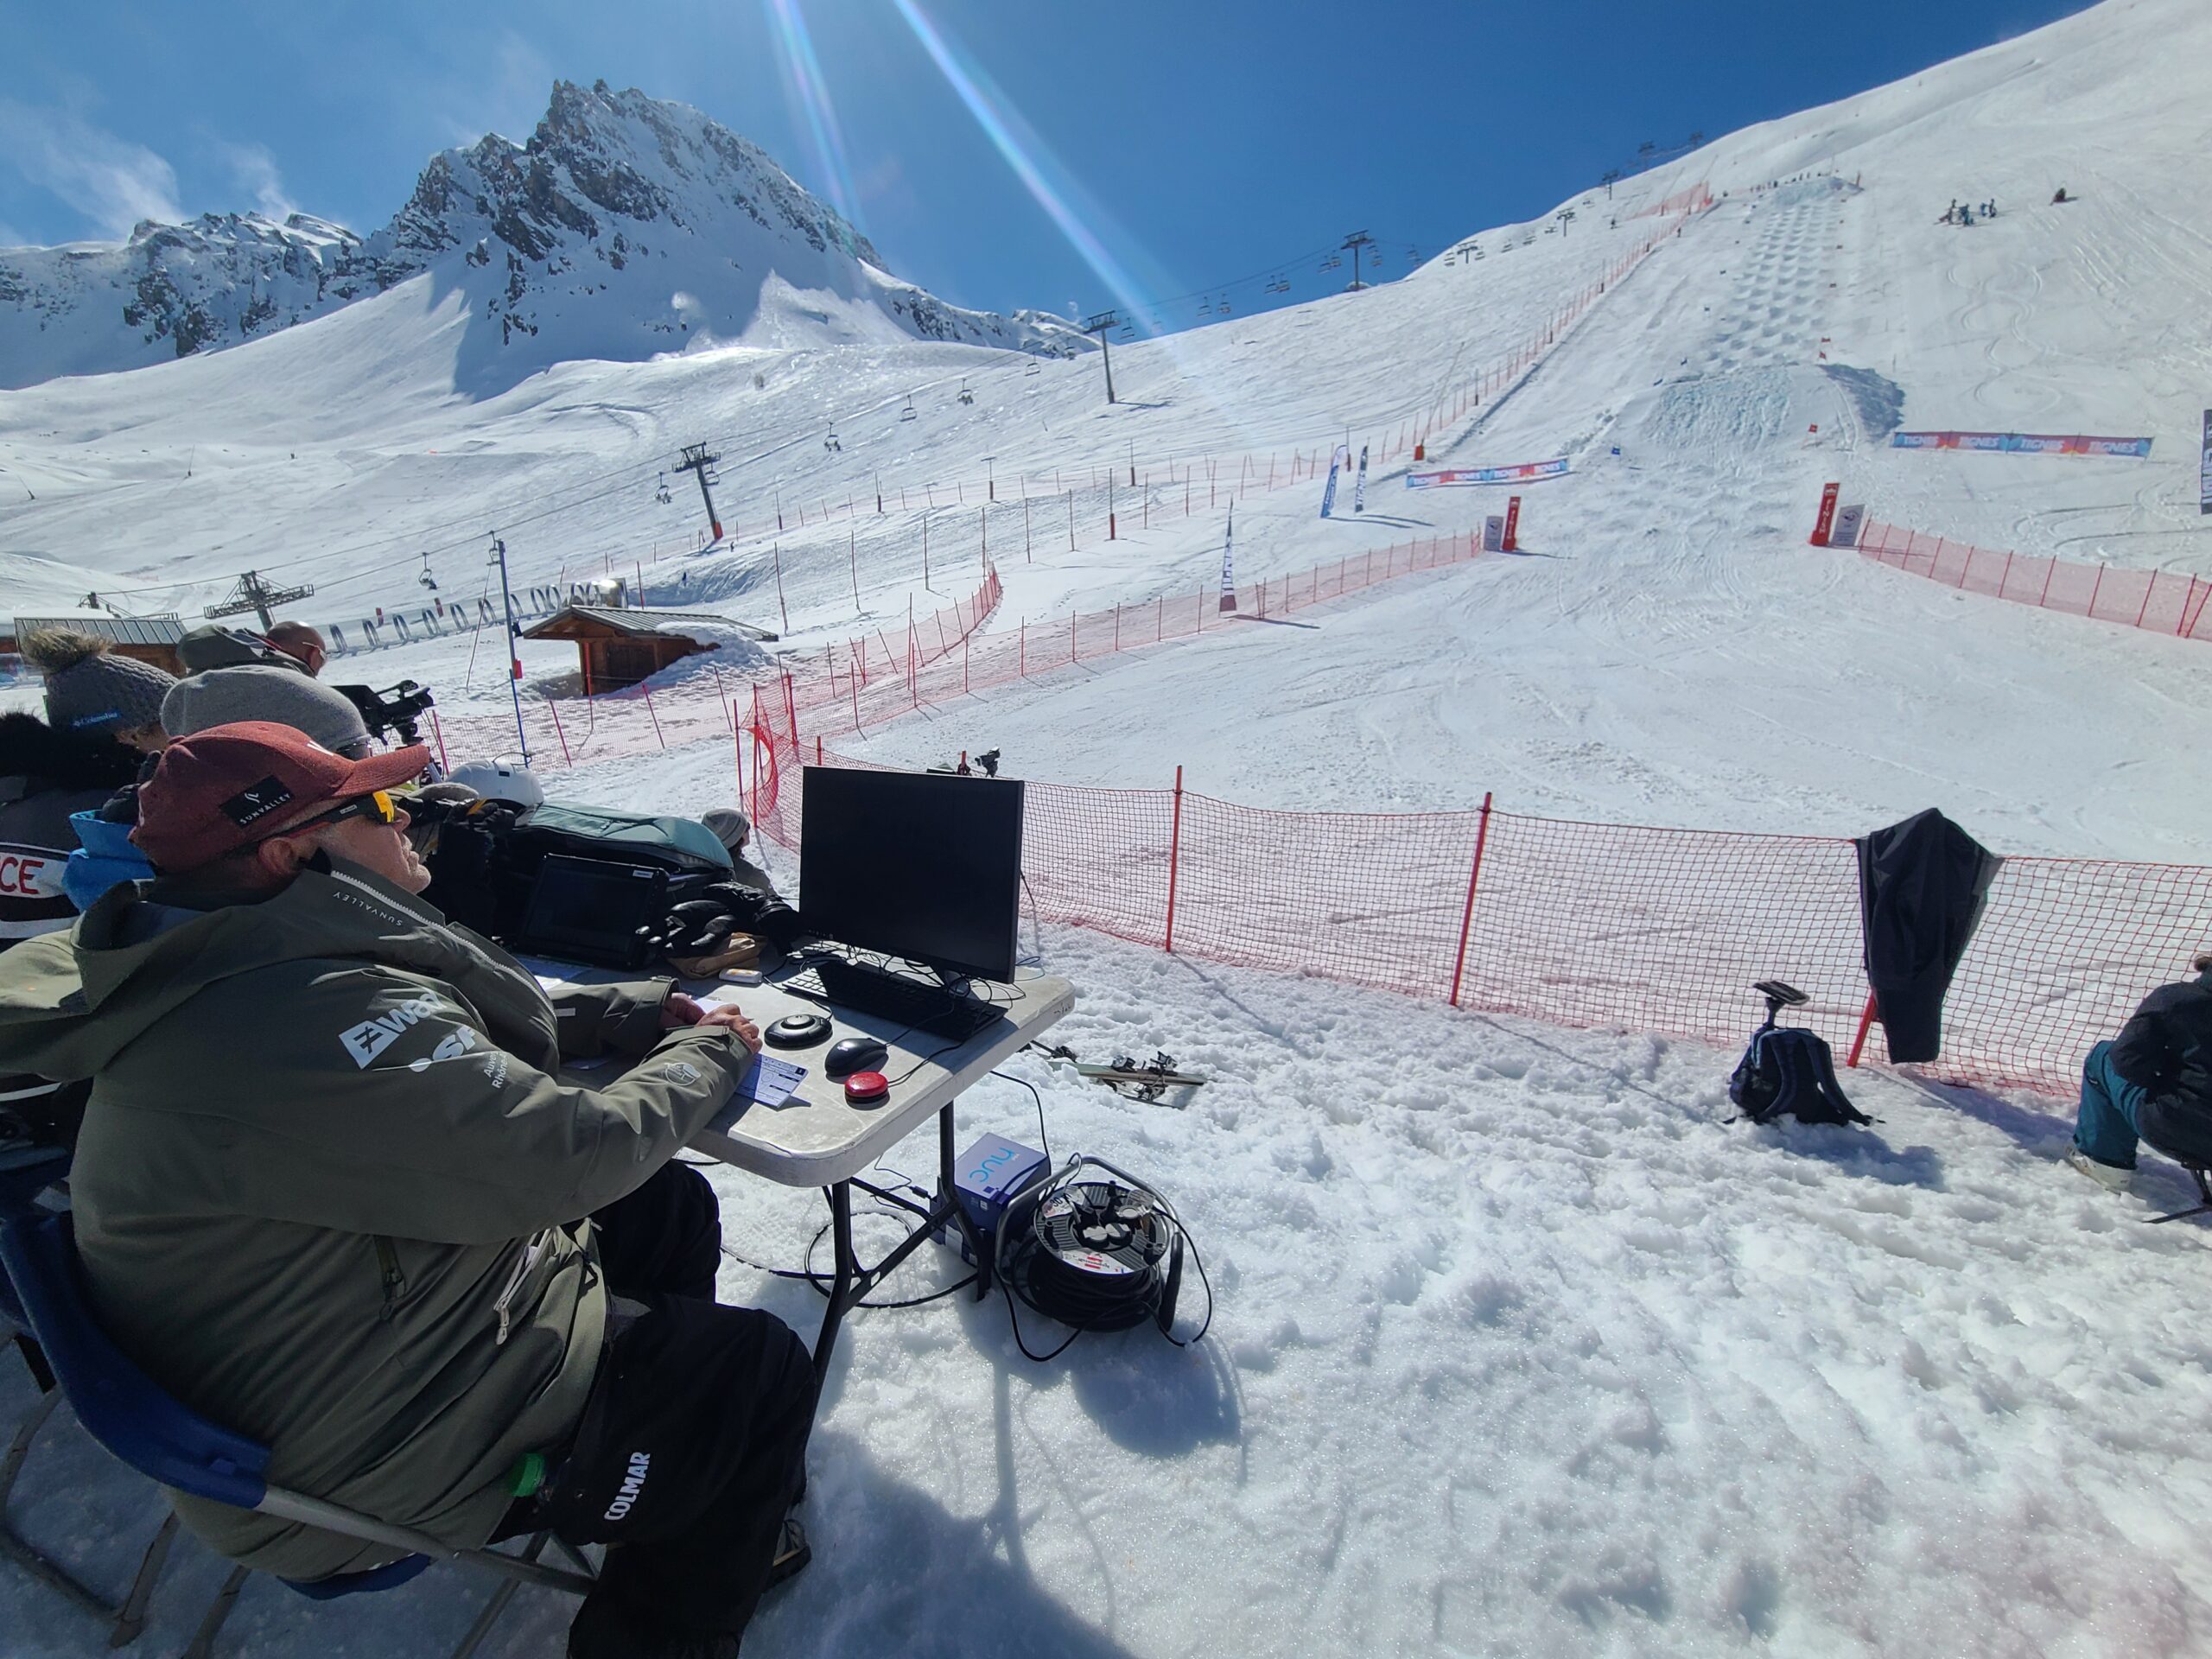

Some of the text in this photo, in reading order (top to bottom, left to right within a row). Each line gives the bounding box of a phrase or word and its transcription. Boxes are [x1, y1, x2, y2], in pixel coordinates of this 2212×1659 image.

[1903, 434, 2139, 453] TIGNES TIGNES TIGNES TIGNES
[239, 792, 291, 824] SUNVALLEY
[333, 891, 404, 927] SUNVALLEY
[969, 1147, 1015, 1183] nuc
[604, 1452, 651, 1520] COLMAR
